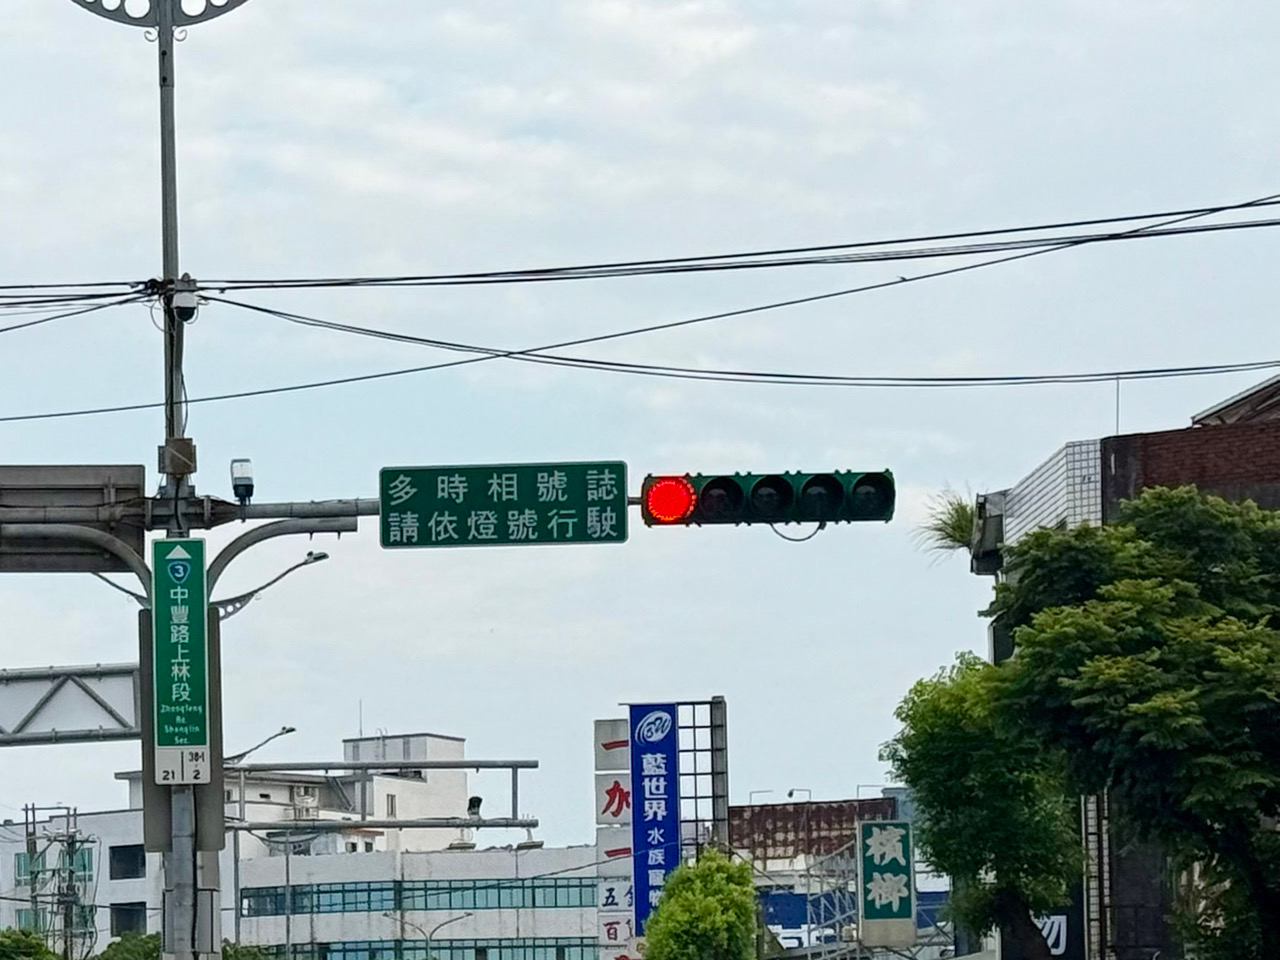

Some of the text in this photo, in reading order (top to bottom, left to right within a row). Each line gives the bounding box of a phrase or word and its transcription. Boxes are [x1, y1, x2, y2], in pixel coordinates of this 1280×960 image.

[387, 469, 618, 504] 多時相號誌
[387, 506, 618, 543] 請依燈號行駛
[173, 565, 185, 577] 3
[170, 585, 192, 702] 中豐路上林段
[162, 769, 175, 780] 21
[193, 769, 201, 780] 2
[865, 825, 909, 913] 檳榔
